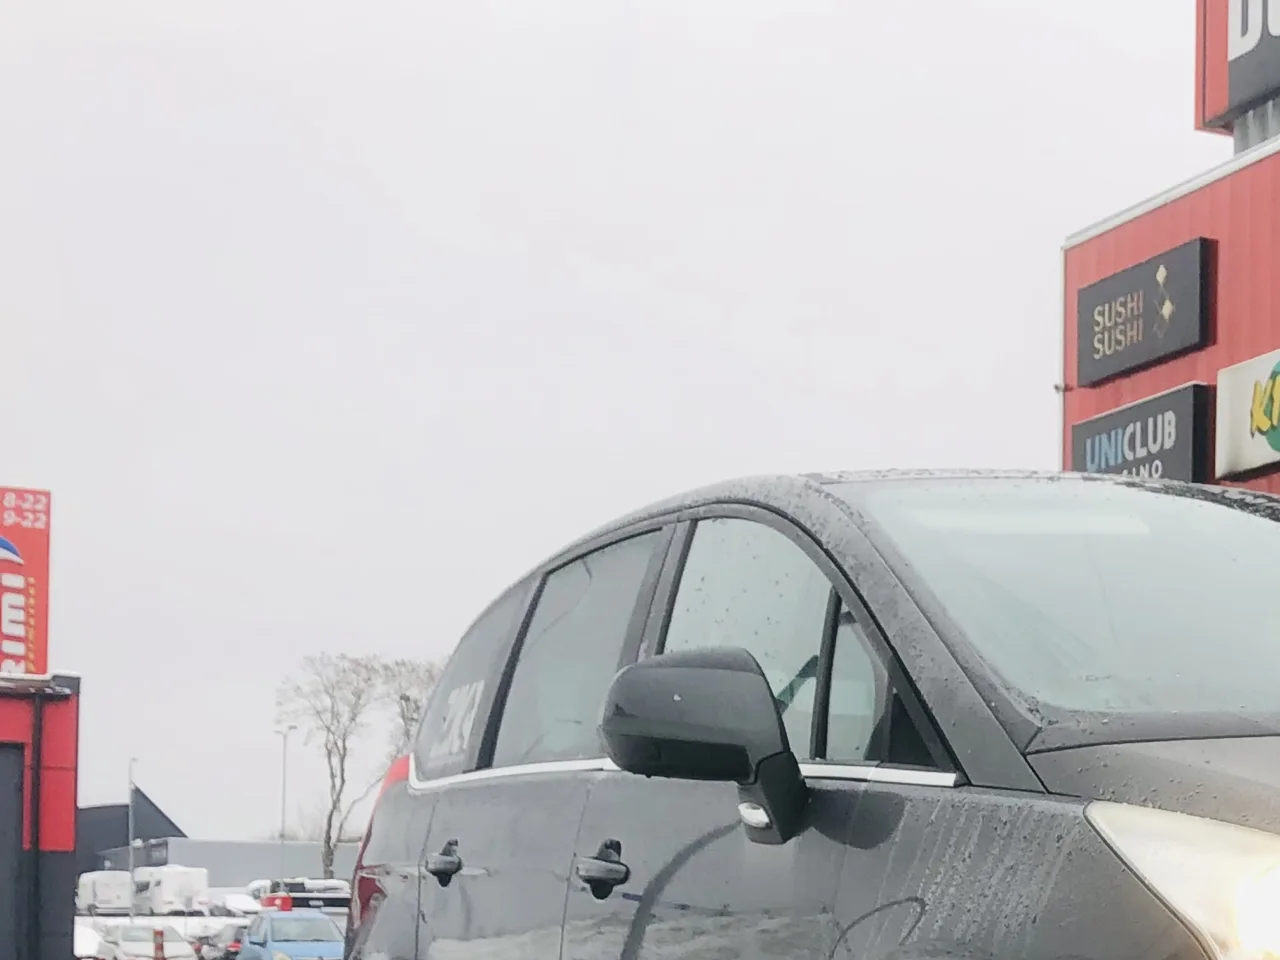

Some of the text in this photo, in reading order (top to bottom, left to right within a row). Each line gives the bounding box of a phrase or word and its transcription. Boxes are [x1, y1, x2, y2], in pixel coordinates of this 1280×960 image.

[1093, 289, 1144, 333] SUSHI
[1093, 319, 1144, 360] SUSHI
[1085, 410, 1177, 473] UNICLUB
